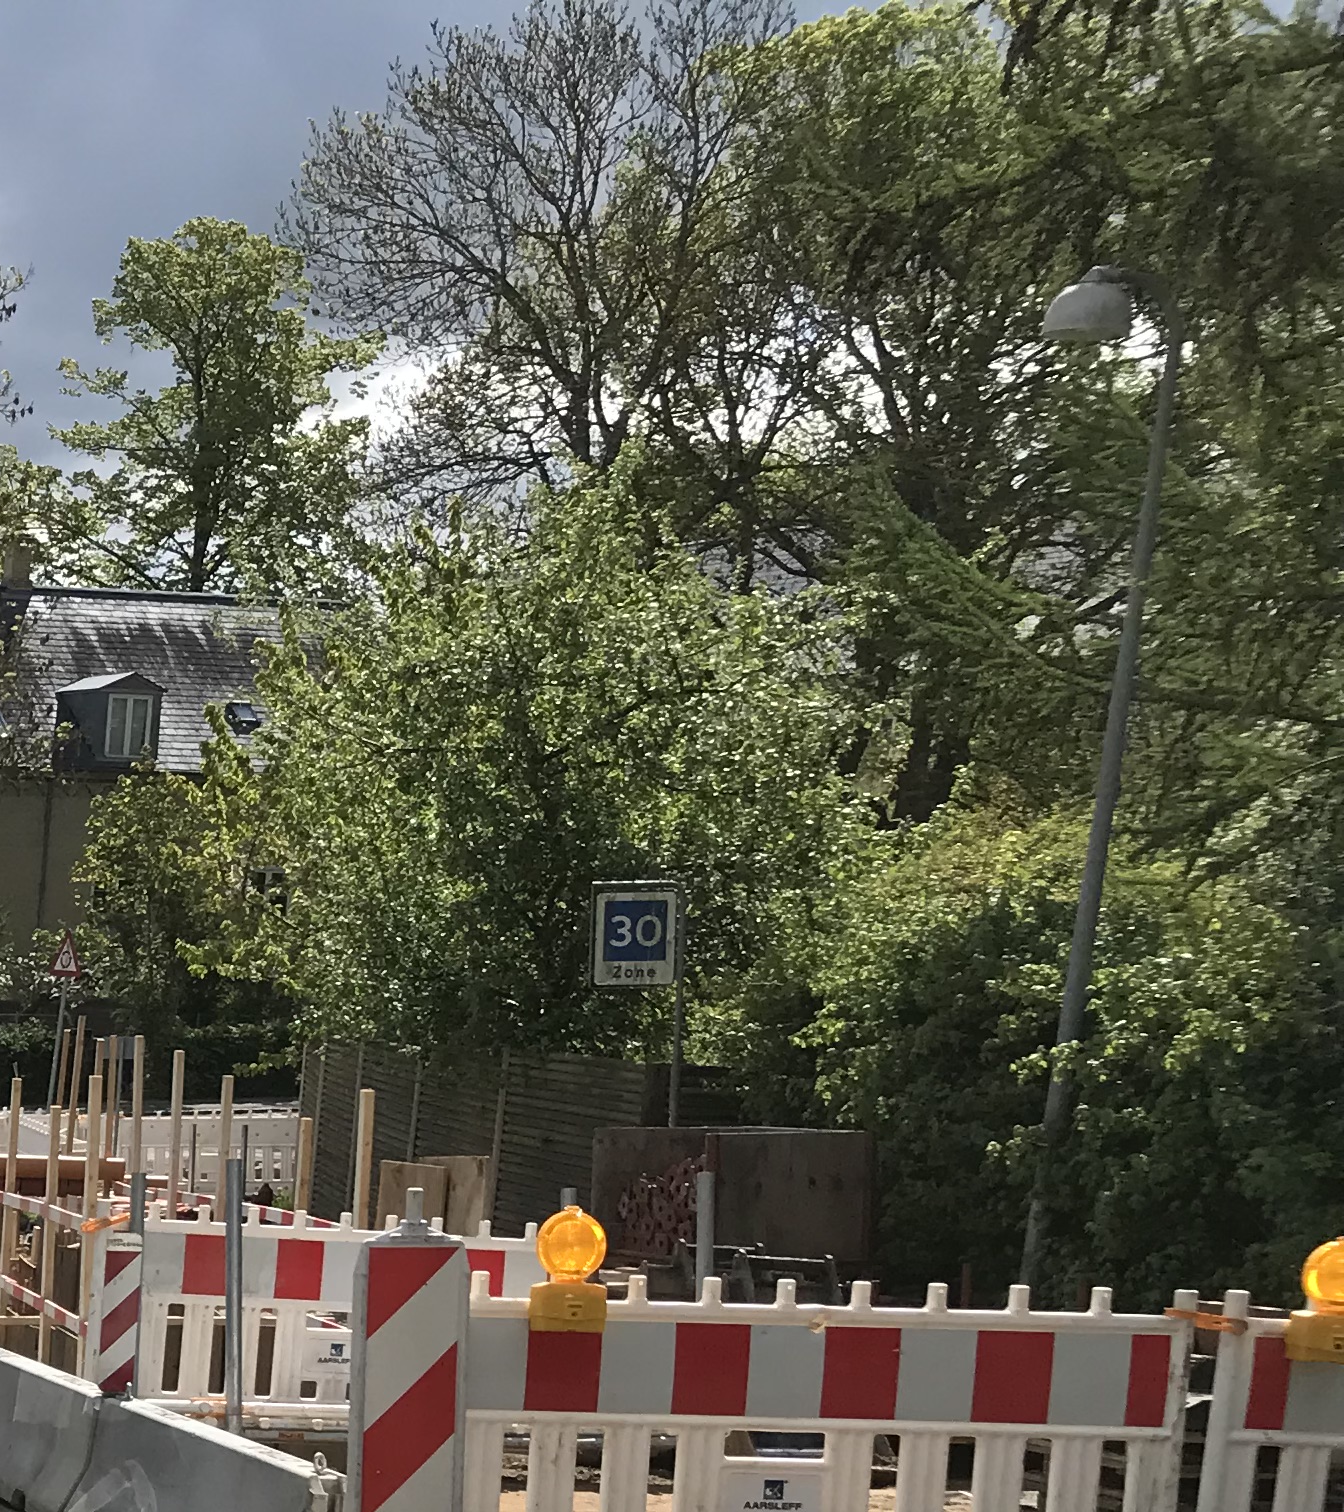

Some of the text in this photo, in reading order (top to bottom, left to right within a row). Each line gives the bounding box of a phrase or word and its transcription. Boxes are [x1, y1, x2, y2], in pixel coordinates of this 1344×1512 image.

[608, 914, 662, 948] 30
[612, 964, 657, 979] Zone
[743, 1501, 802, 1511] AARSLEFF
